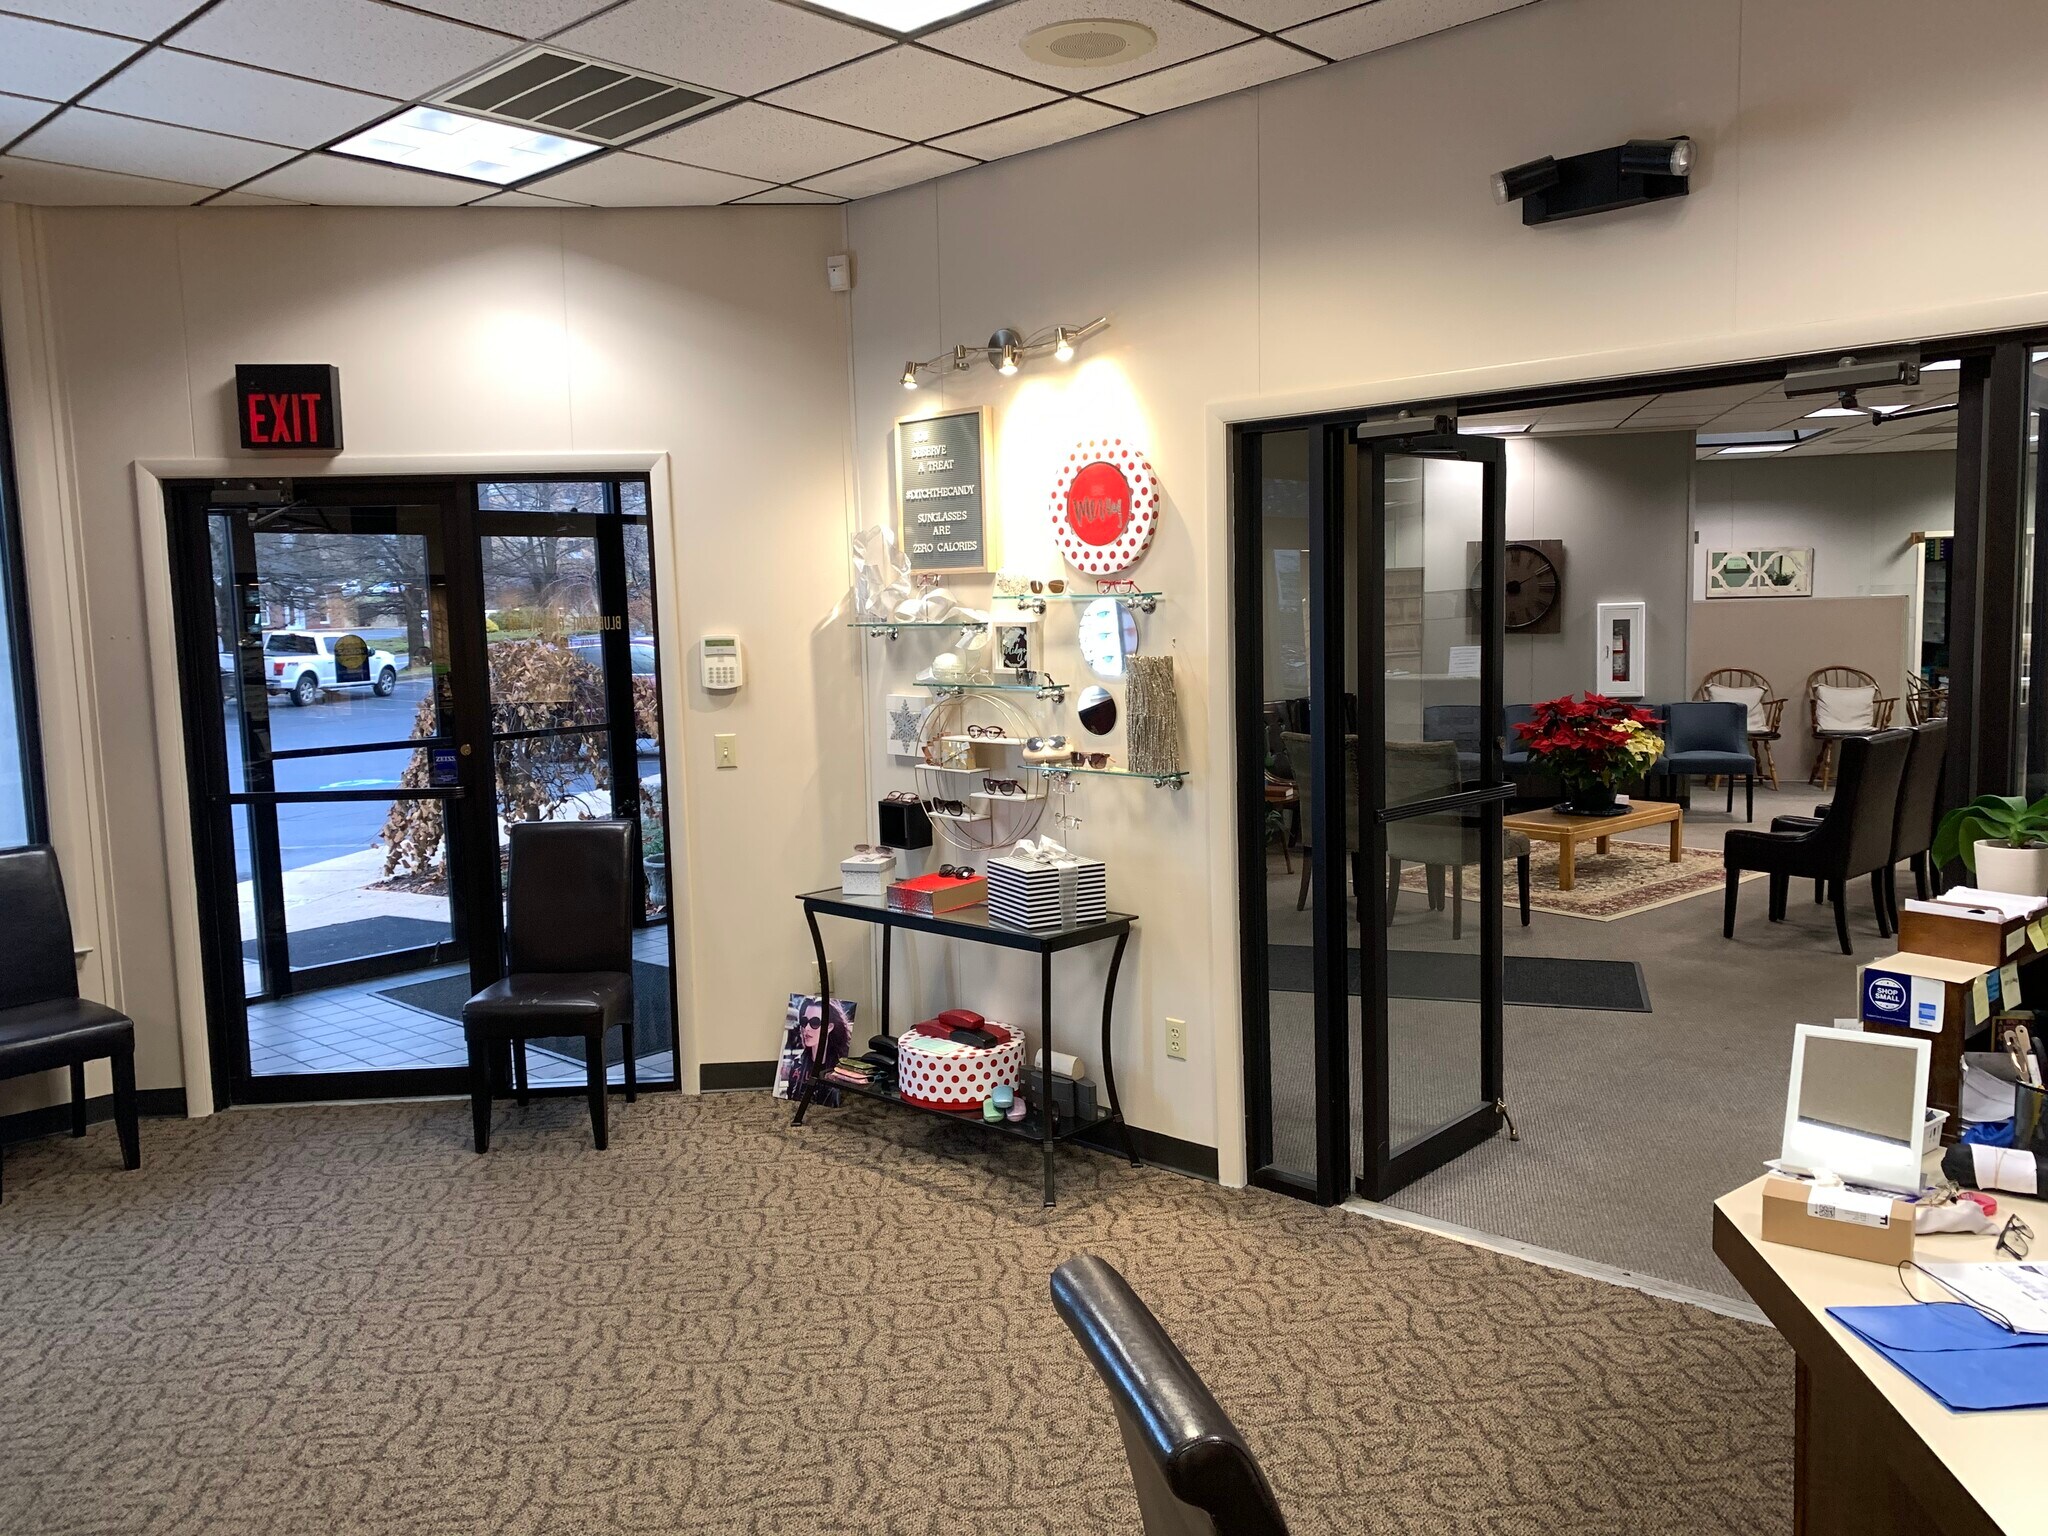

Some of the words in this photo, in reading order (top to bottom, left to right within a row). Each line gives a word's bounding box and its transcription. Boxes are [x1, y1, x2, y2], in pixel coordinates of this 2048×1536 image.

[247, 393, 321, 443] EXIT
[911, 445, 947, 457] DESERVE
[917, 461, 925, 473] A
[928, 459, 955, 472] TREAT
[905, 484, 975, 500] #DITCHTHECANDY
[917, 510, 968, 523] SUNGLASSES
[932, 525, 951, 536] ARE
[912, 542, 934, 554] ZERO
[937, 540, 978, 553] CALORIES
[1874, 992, 1900, 1003] SMALL
[1876, 987, 1899, 996] SHOP
